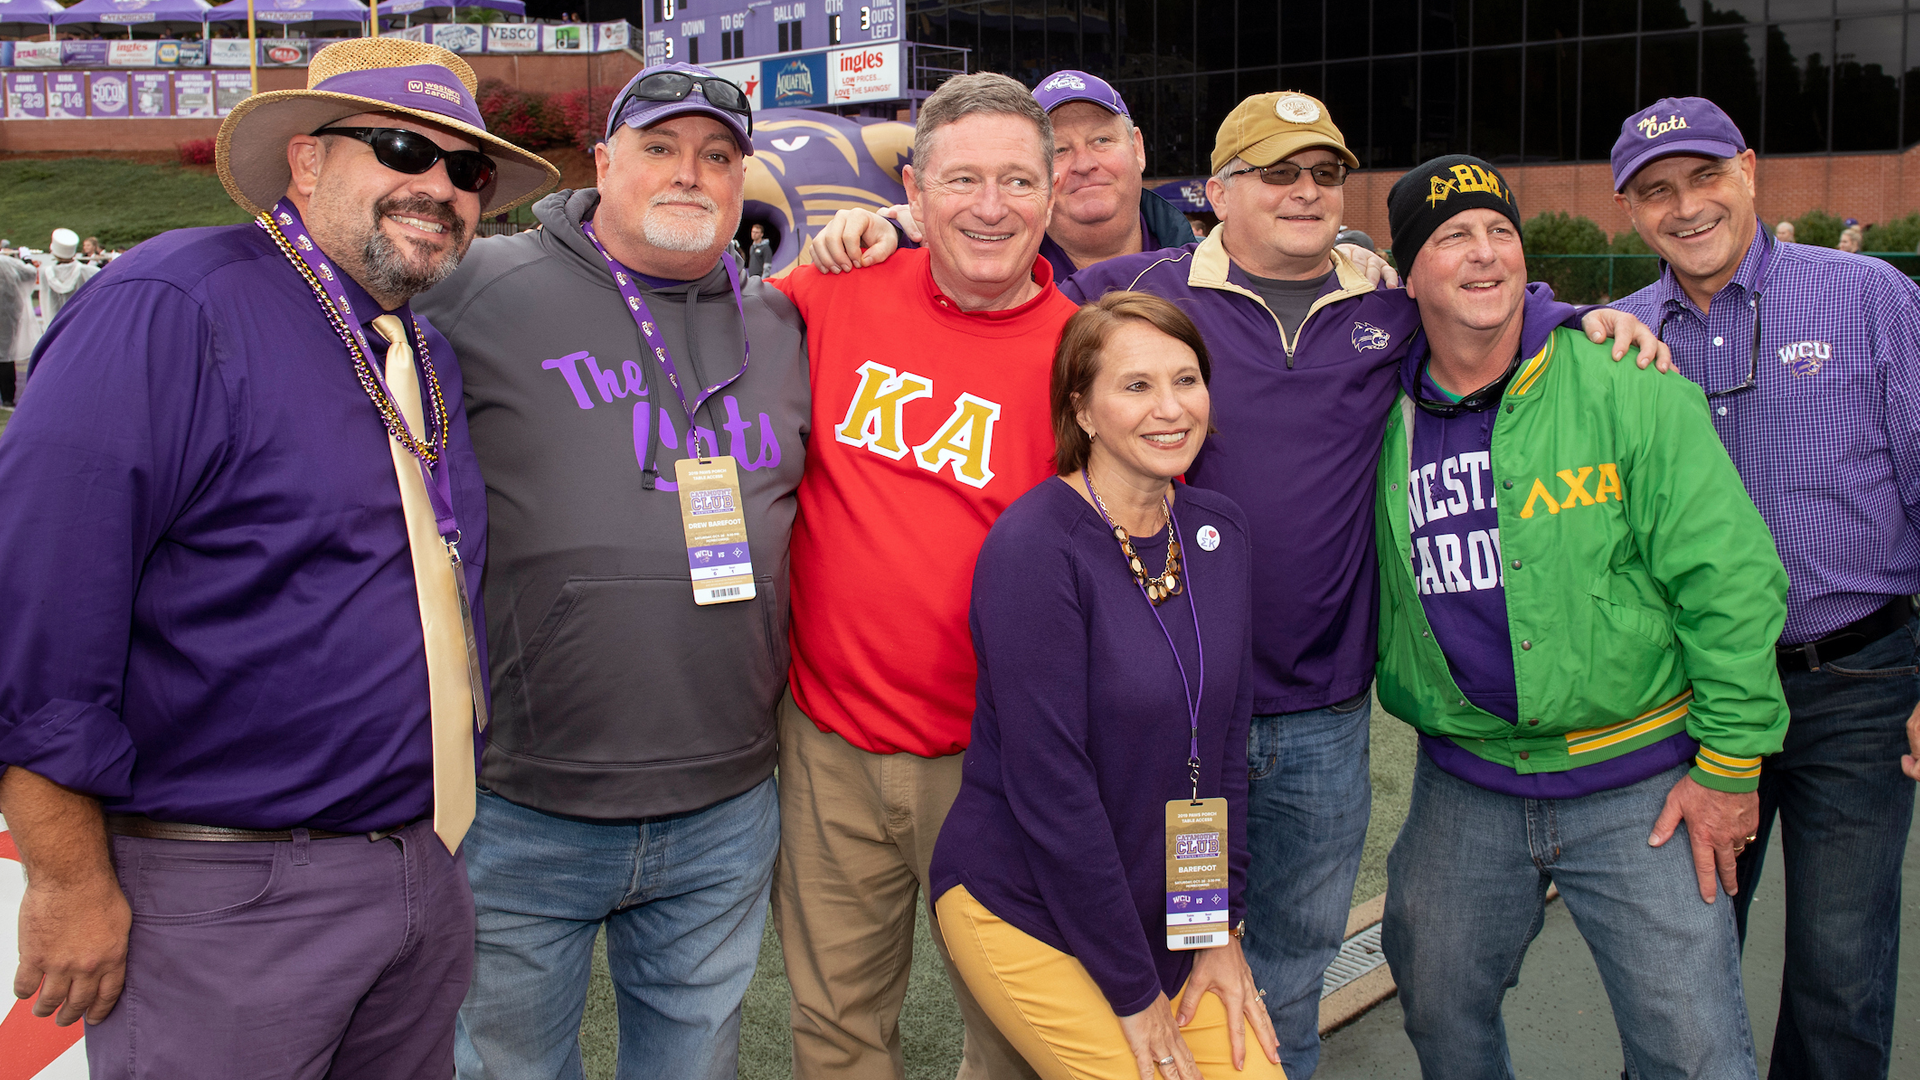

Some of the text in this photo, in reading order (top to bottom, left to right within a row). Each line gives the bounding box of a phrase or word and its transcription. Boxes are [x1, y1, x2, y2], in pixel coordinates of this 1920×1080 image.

[773, 2, 806, 22] BALL ON
[825, 0, 844, 14] QTR
[720, 15, 731, 31] TO
[861, 6, 871, 30] 3
[871, 8, 895, 24] OUTS
[490, 27, 536, 40] VESCO
[681, 19, 705, 37] DOWN
[871, 24, 892, 39] LEFT
[649, 30, 665, 43] TIME
[17, 49, 37, 58] STAR
[116, 43, 148, 52] ingles
[275, 50, 295, 59] KIA
[647, 43, 665, 57] OUTS
[665, 37, 674, 59] 3
[840, 50, 884, 73] ingles
[92, 82, 127, 103] SOCON
[425, 82, 460, 98] western
[776, 71, 814, 98] AQUAFINA
[23, 93, 44, 108] 23
[64, 93, 82, 108] 14
[425, 89, 460, 105] carolina
[1637, 115, 1657, 131] The
[1646, 115, 1687, 139] Cats
[279, 212, 294, 225] WCU
[297, 234, 313, 251] WCU
[319, 262, 334, 281] WCU
[339, 295, 351, 314] WCU
[1777, 340, 1832, 365] WCU
[541, 350, 649, 409] The
[690, 489, 731, 497] CATAMOUNT
[691, 495, 733, 511] CLUB
[688, 518, 741, 529] DREW BAREFOOT
[694, 550, 713, 558] WCU
[1176, 833, 1219, 841] CATAMOUNT
[1176, 839, 1219, 855] CLUB
[1178, 864, 1217, 873] BAREFOOT
[1172, 895, 1191, 904] WCU
